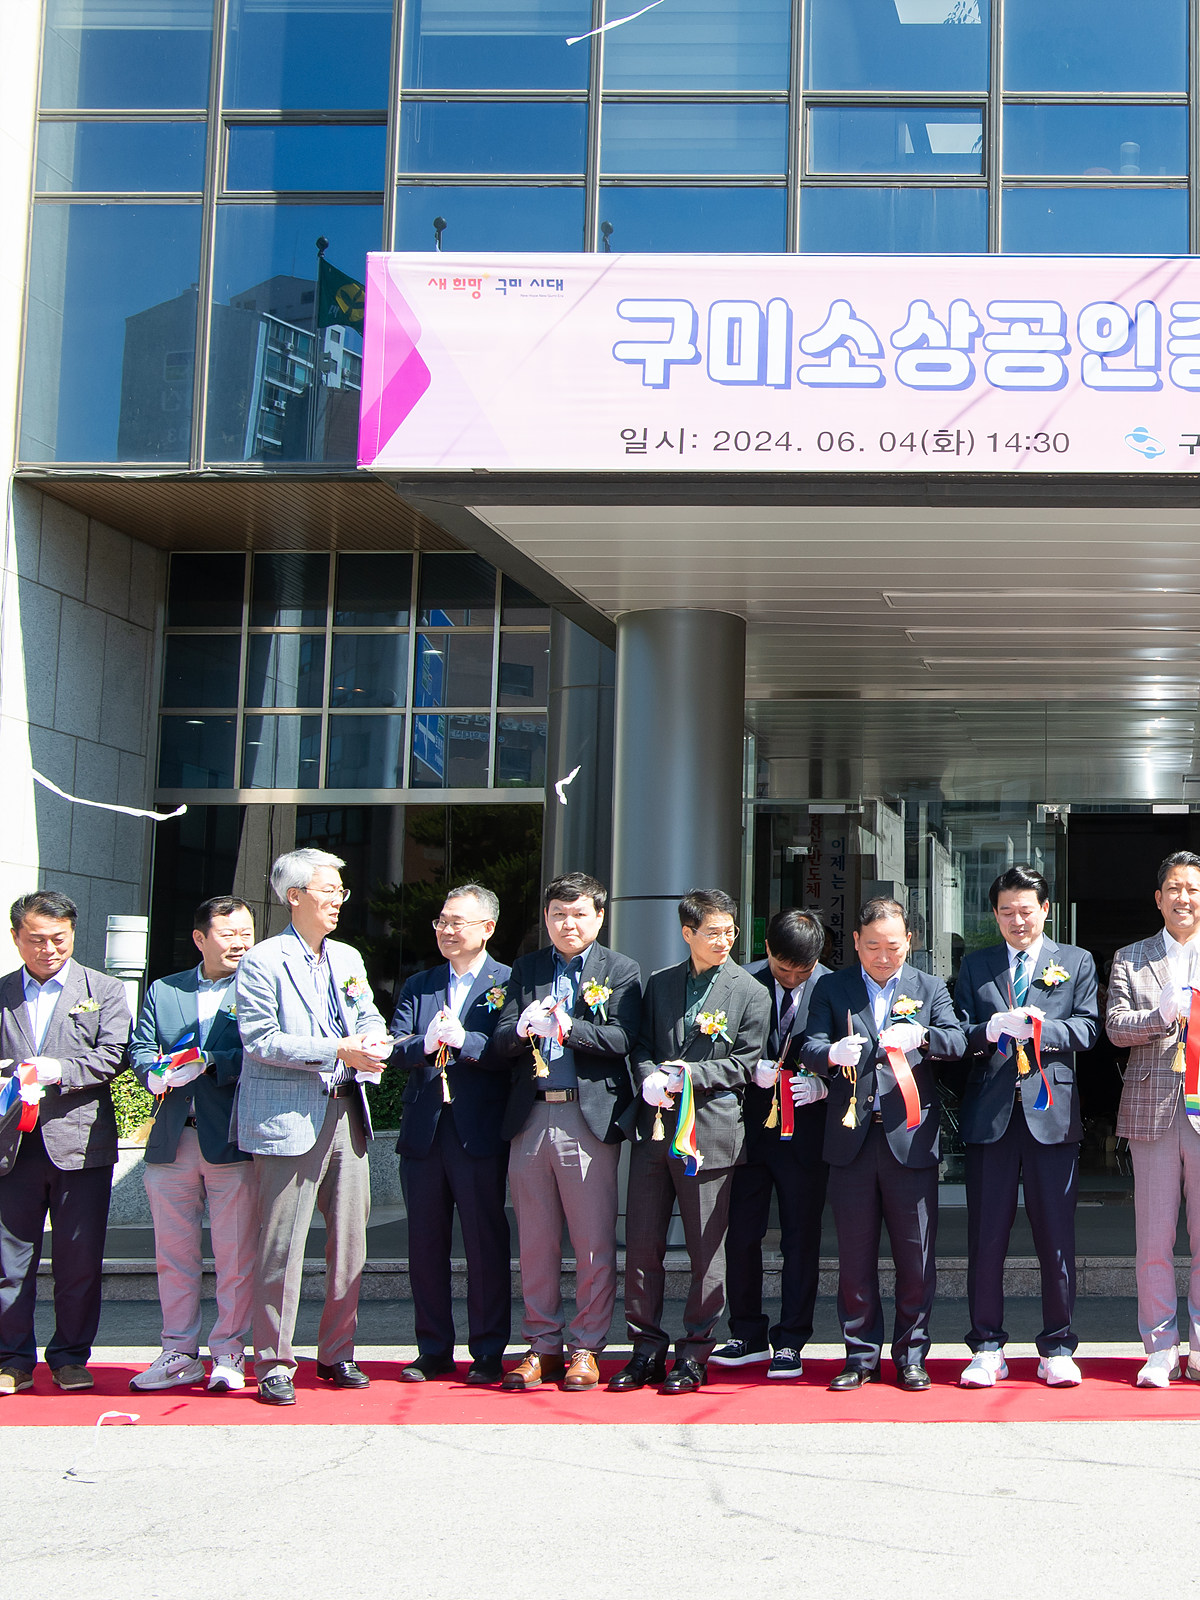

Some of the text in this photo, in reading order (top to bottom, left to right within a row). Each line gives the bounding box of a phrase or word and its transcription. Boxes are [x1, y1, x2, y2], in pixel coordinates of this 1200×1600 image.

[427, 277, 564, 300] 새 희망 구미 시대
[620, 428, 1070, 457] 일시: 2024. 06. 04(화) 14:30
